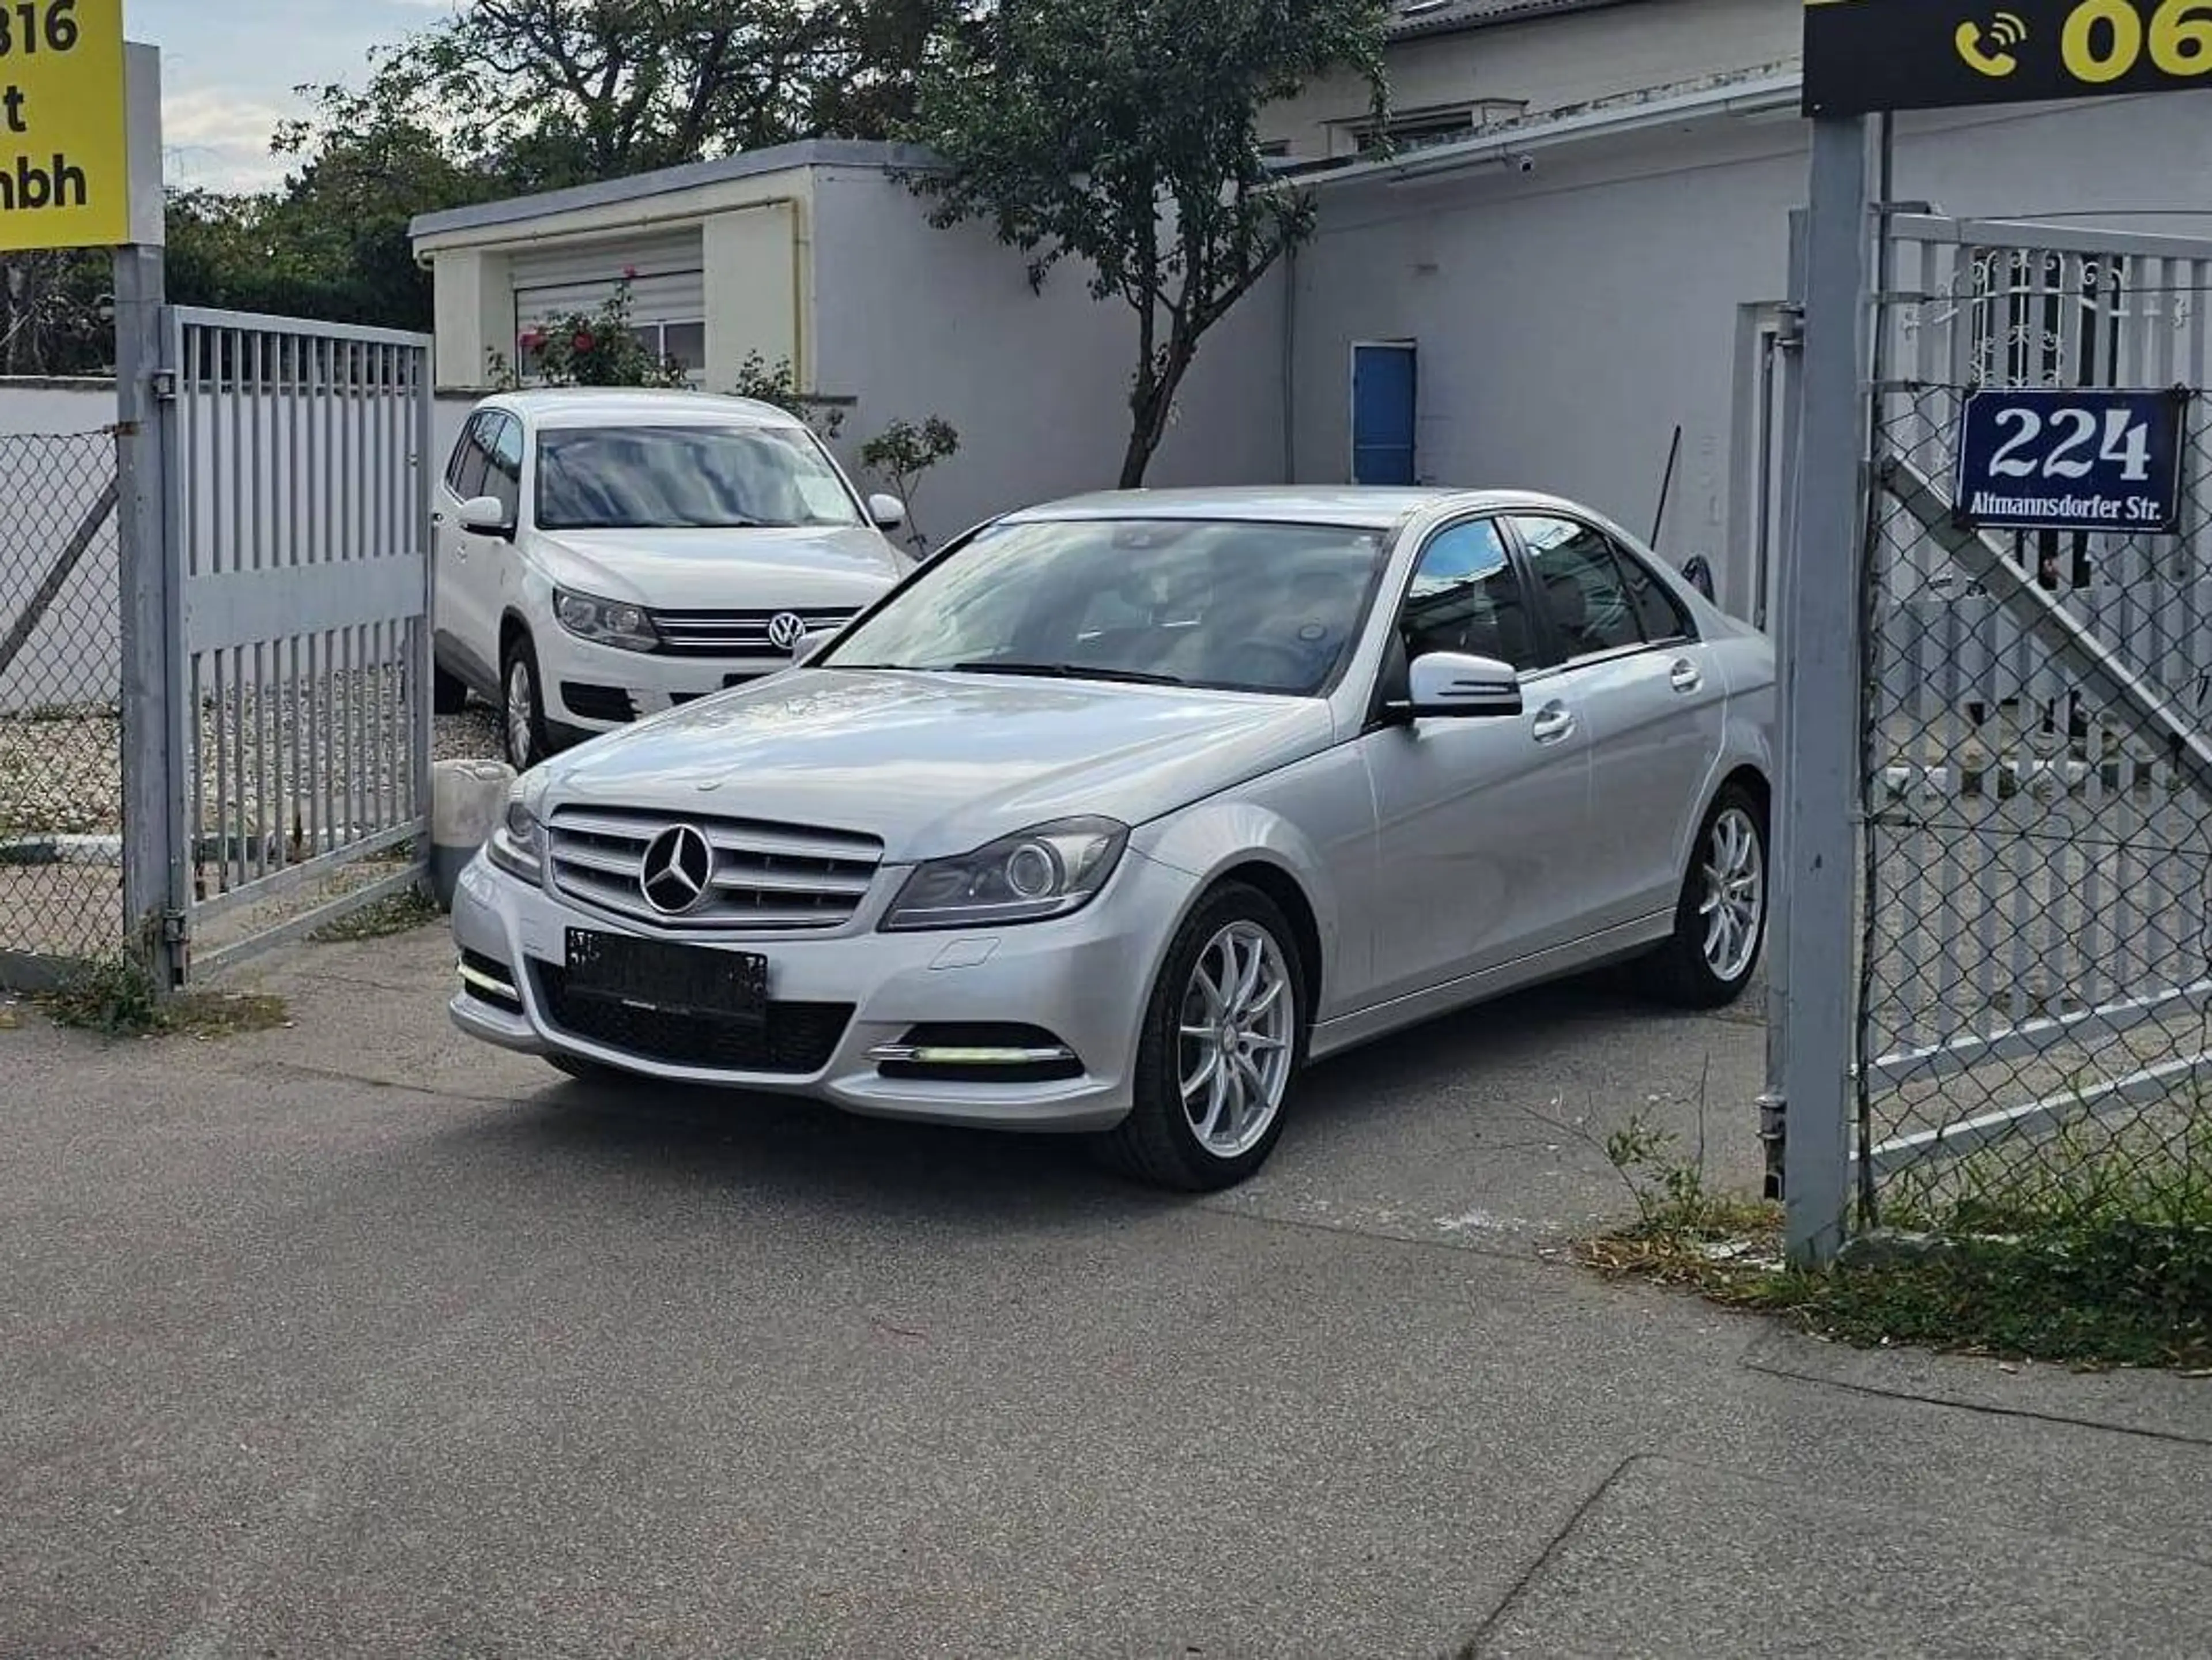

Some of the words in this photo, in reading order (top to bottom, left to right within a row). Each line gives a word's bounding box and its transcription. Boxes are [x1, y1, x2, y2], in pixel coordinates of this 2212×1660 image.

[1988, 408, 2152, 481] 224
[1970, 492, 2122, 519] Altmannsdorfer
[2126, 496, 2162, 520] Str.
